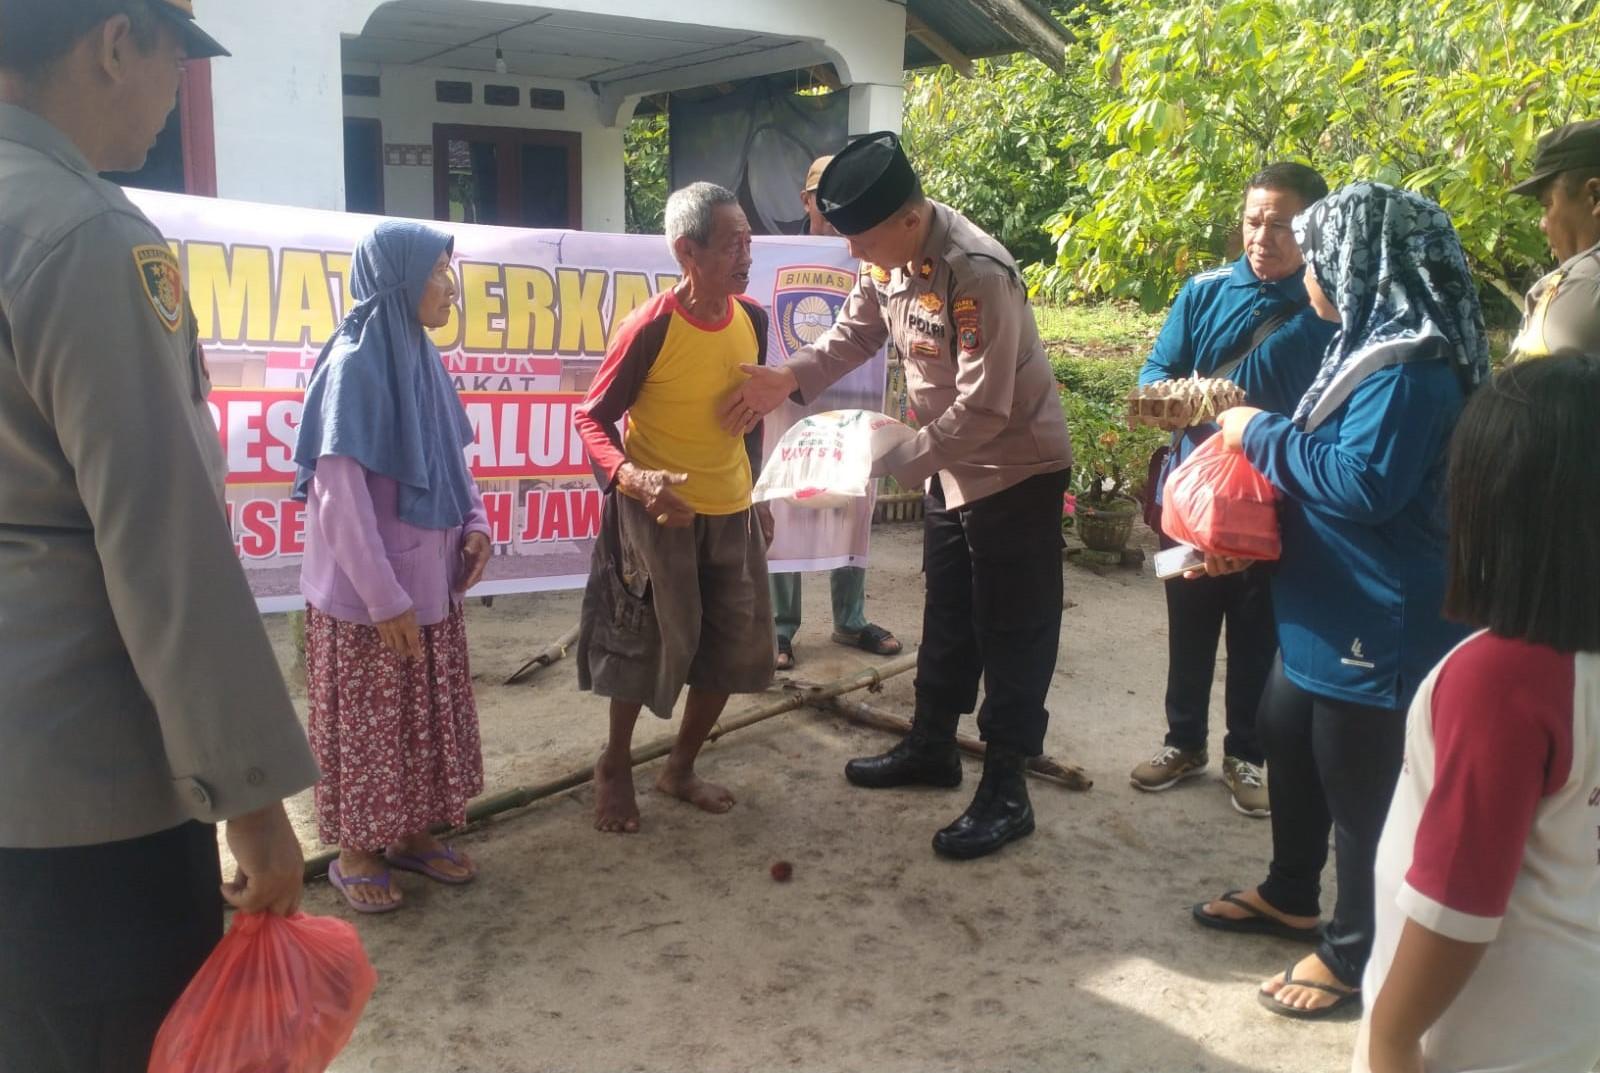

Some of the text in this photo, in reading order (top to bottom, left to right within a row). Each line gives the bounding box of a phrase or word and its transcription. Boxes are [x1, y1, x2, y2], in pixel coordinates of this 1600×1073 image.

[164, 239, 352, 345] MAT
[786, 272, 845, 289] BINMAS
[908, 313, 946, 338] POLRI
[447, 355, 534, 373] NTUK
[521, 490, 602, 541] JAW
